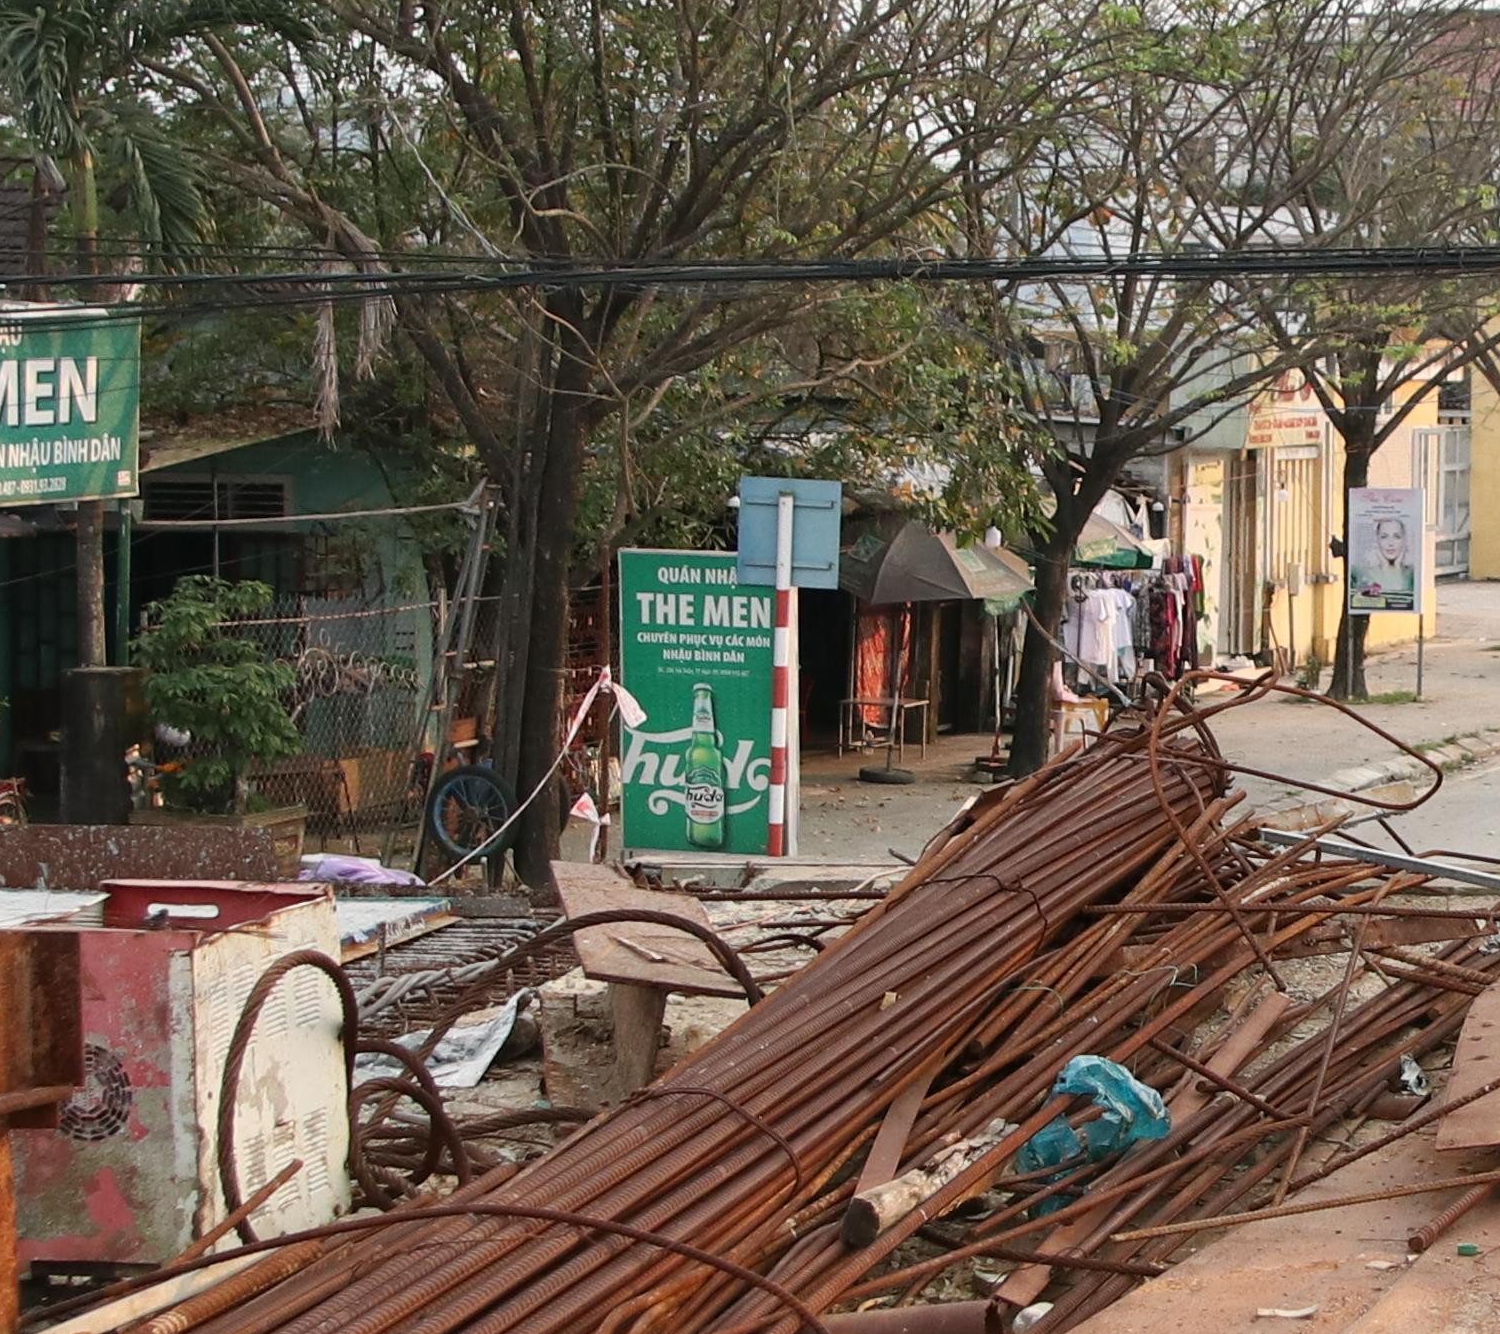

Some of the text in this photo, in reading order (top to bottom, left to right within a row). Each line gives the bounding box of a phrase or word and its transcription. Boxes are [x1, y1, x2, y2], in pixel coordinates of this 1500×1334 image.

[8, 437, 51, 474] NHẬU
[53, 435, 89, 465] BÌNH
[91, 432, 121, 462] DÂN
[657, 565, 738, 589] QUÁN NHẬ
[636, 592, 771, 629] THE MEN
[637, 631, 771, 649] CHUYÊN PHỤC VỤ CÁC MÓN
[662, 648, 745, 664] NHẬU BÌNH DÂN
